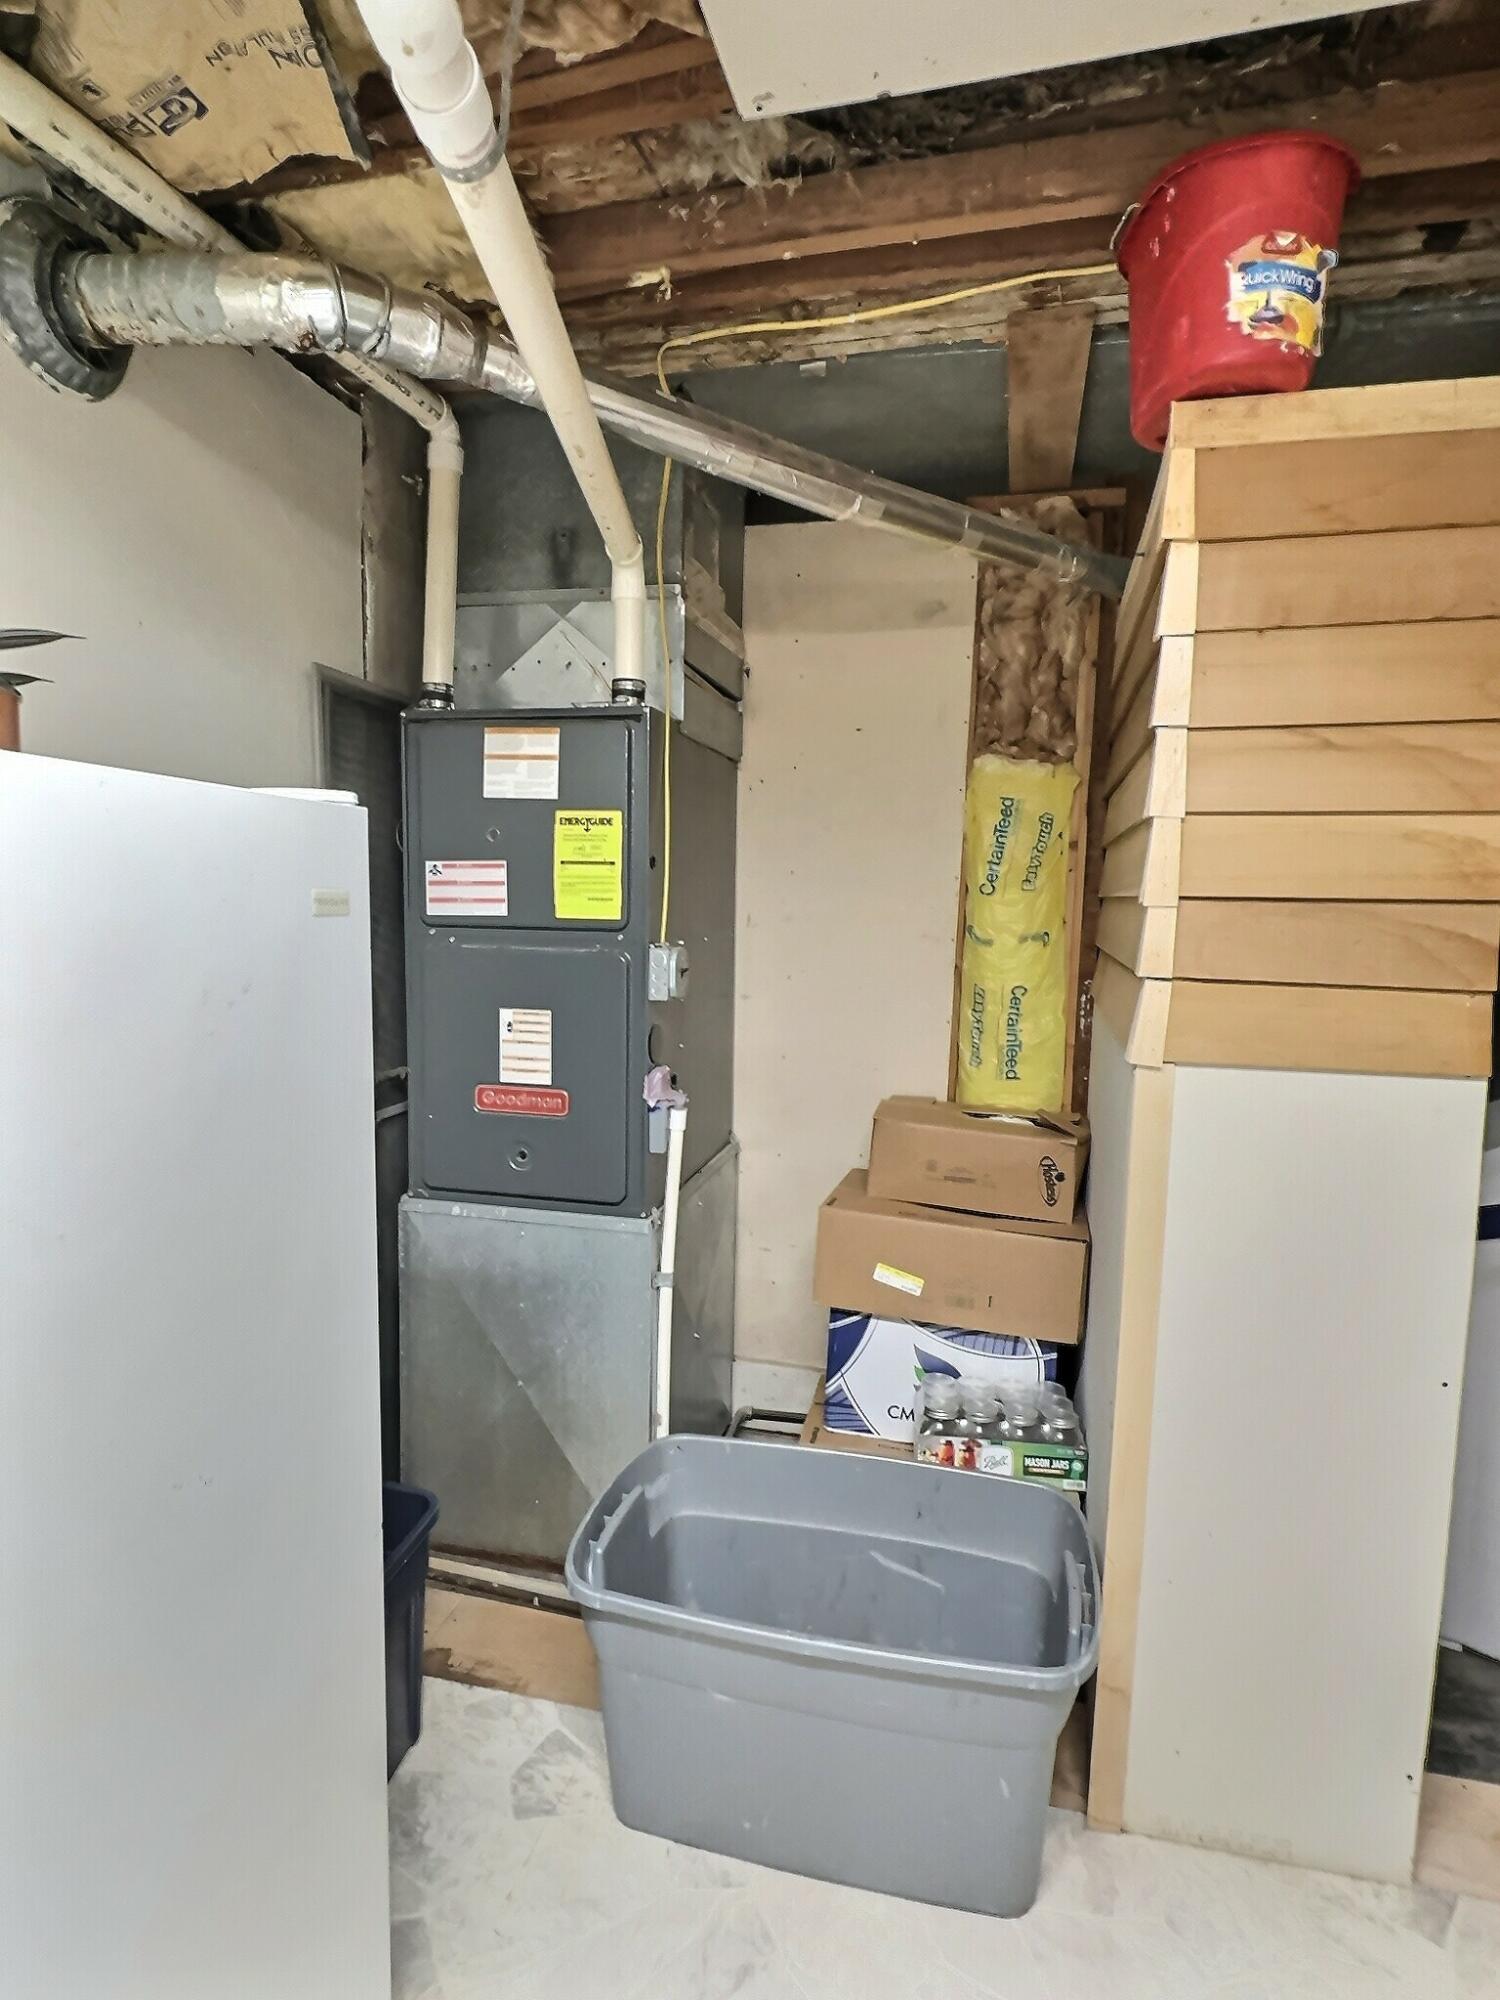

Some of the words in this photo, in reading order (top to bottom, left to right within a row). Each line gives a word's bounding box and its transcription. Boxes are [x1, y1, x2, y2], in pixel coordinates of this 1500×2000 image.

[979, 796, 1015, 896] CertainTeed
[1005, 985, 1028, 1080] CertainTeed
[481, 1090, 563, 1109] Goodman
[1024, 1456, 1051, 1469] MASON
[1051, 1459, 1070, 1471] JARS
